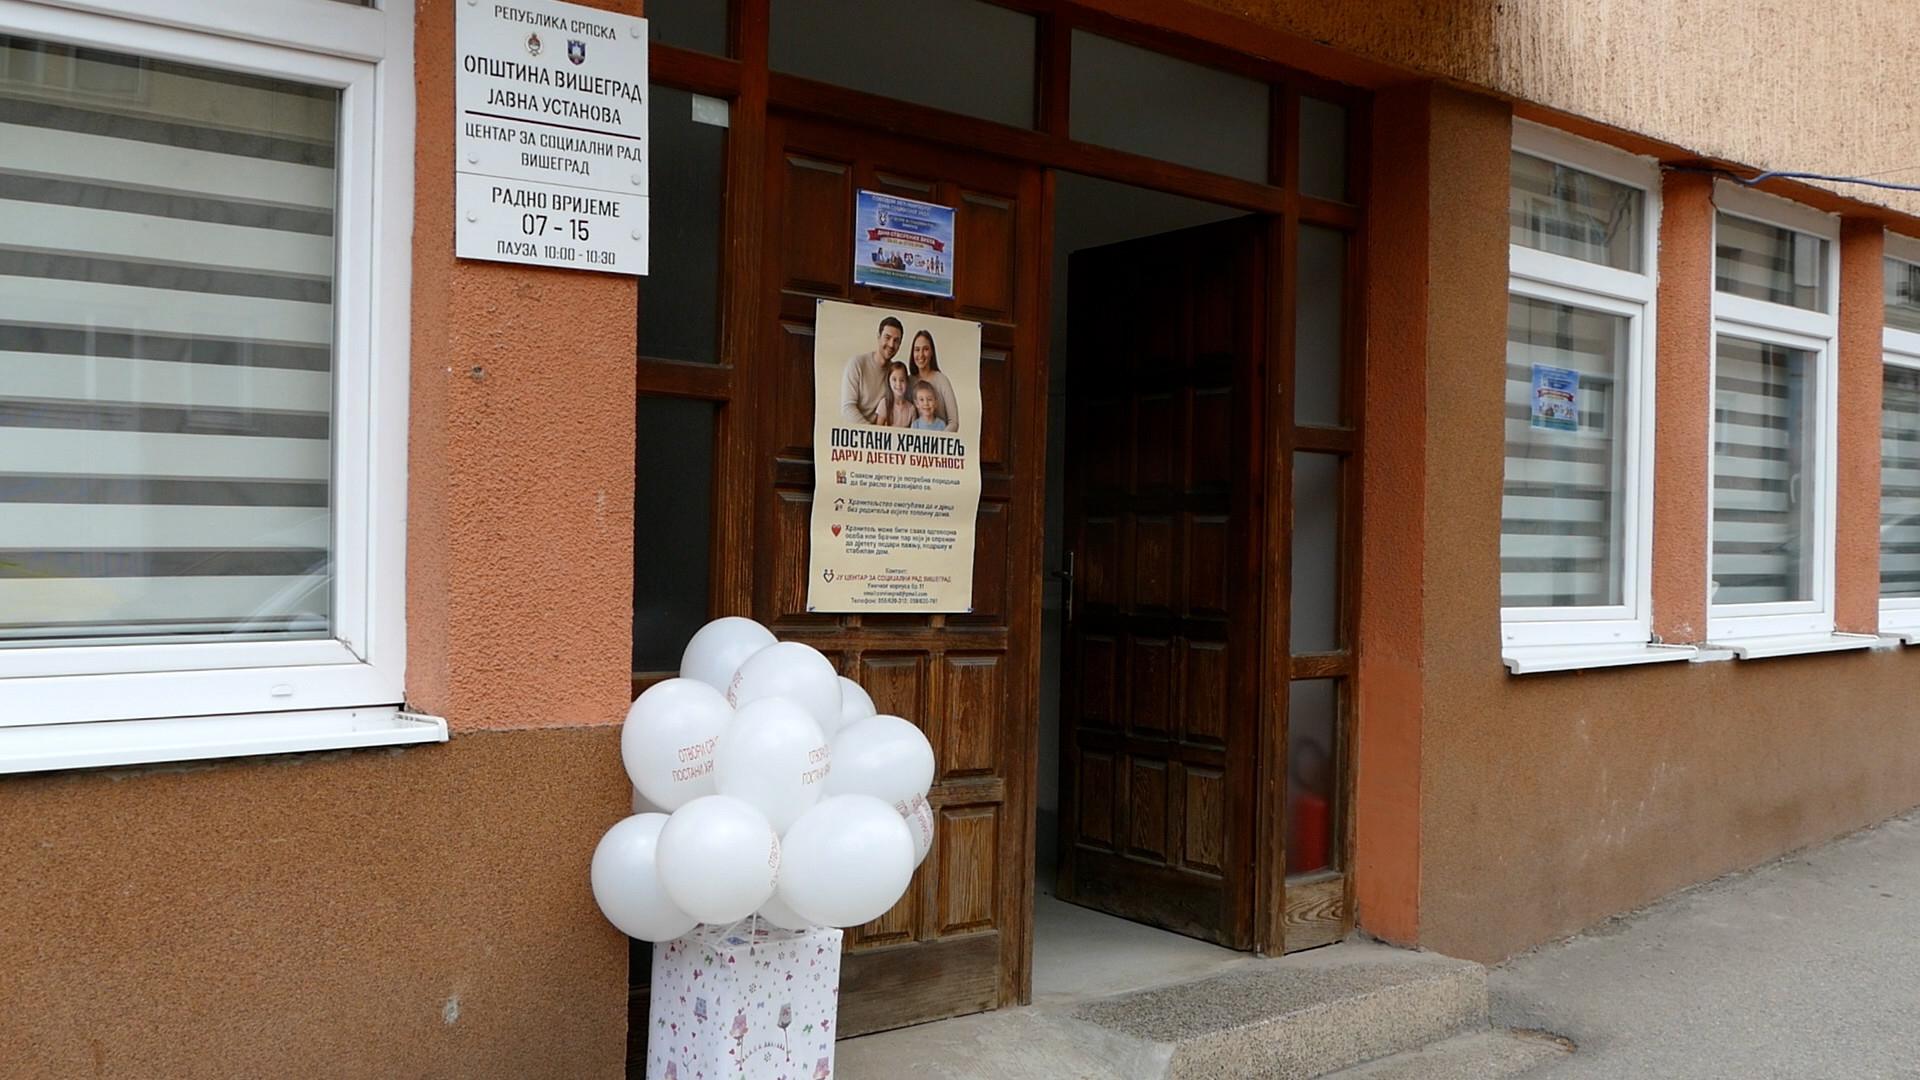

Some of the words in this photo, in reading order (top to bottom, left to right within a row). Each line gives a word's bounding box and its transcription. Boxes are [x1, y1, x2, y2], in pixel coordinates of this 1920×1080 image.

[494, 5, 568, 31] РЕПУБЛИКА
[570, 20, 616, 40] СРПСКА
[464, 55, 550, 86] ОПШТИНА
[555, 70, 642, 105] ВИШЕГРАД
[487, 89, 539, 112] ЈАВНА
[542, 97, 622, 125] УСТАНОВА
[465, 122, 516, 142] ЦЕНТАР
[519, 130, 536, 146] ЗА
[540, 134, 613, 157] СОЦИЈАЛНИ
[617, 146, 642, 162] РАД
[521, 153, 590, 176] ВИШЕГРАД
[492, 187, 547, 209] РАДНО
[552, 194, 620, 218] ВРИЈЕМЕ
[522, 213, 548, 236] 07
[569, 219, 590, 241] 15
[497, 240, 538, 257] ПАУЗА
[544, 245, 575, 261] 10:00
[586, 250, 616, 265] 10:30
[831, 428, 892, 451] ПОСТАНИ
[897, 433, 965, 456] ХРАНИТЕЉ
[831, 449, 863, 462] ДАРУЈ
[867, 451, 907, 465] ДЈЕТЕТУ
[910, 455, 965, 470] БУДУЋНОСТ
[850, 471, 873, 479] Сваком
[874, 473, 896, 482] дјетету
[904, 476, 931, 484] потребна
[932, 478, 960, 486] породица
[868, 481, 887, 489] расло
[893, 483, 923, 491] развијало
[848, 499, 893, 508] Хранитељство
[894, 501, 924, 510] омогућава
[859, 507, 889, 516] родитеља
[910, 510, 933, 518] топлину
[845, 524, 876, 533] Хранитељ
[877, 533, 899, 541] брачни
[854, 540, 876, 549] дјетету
